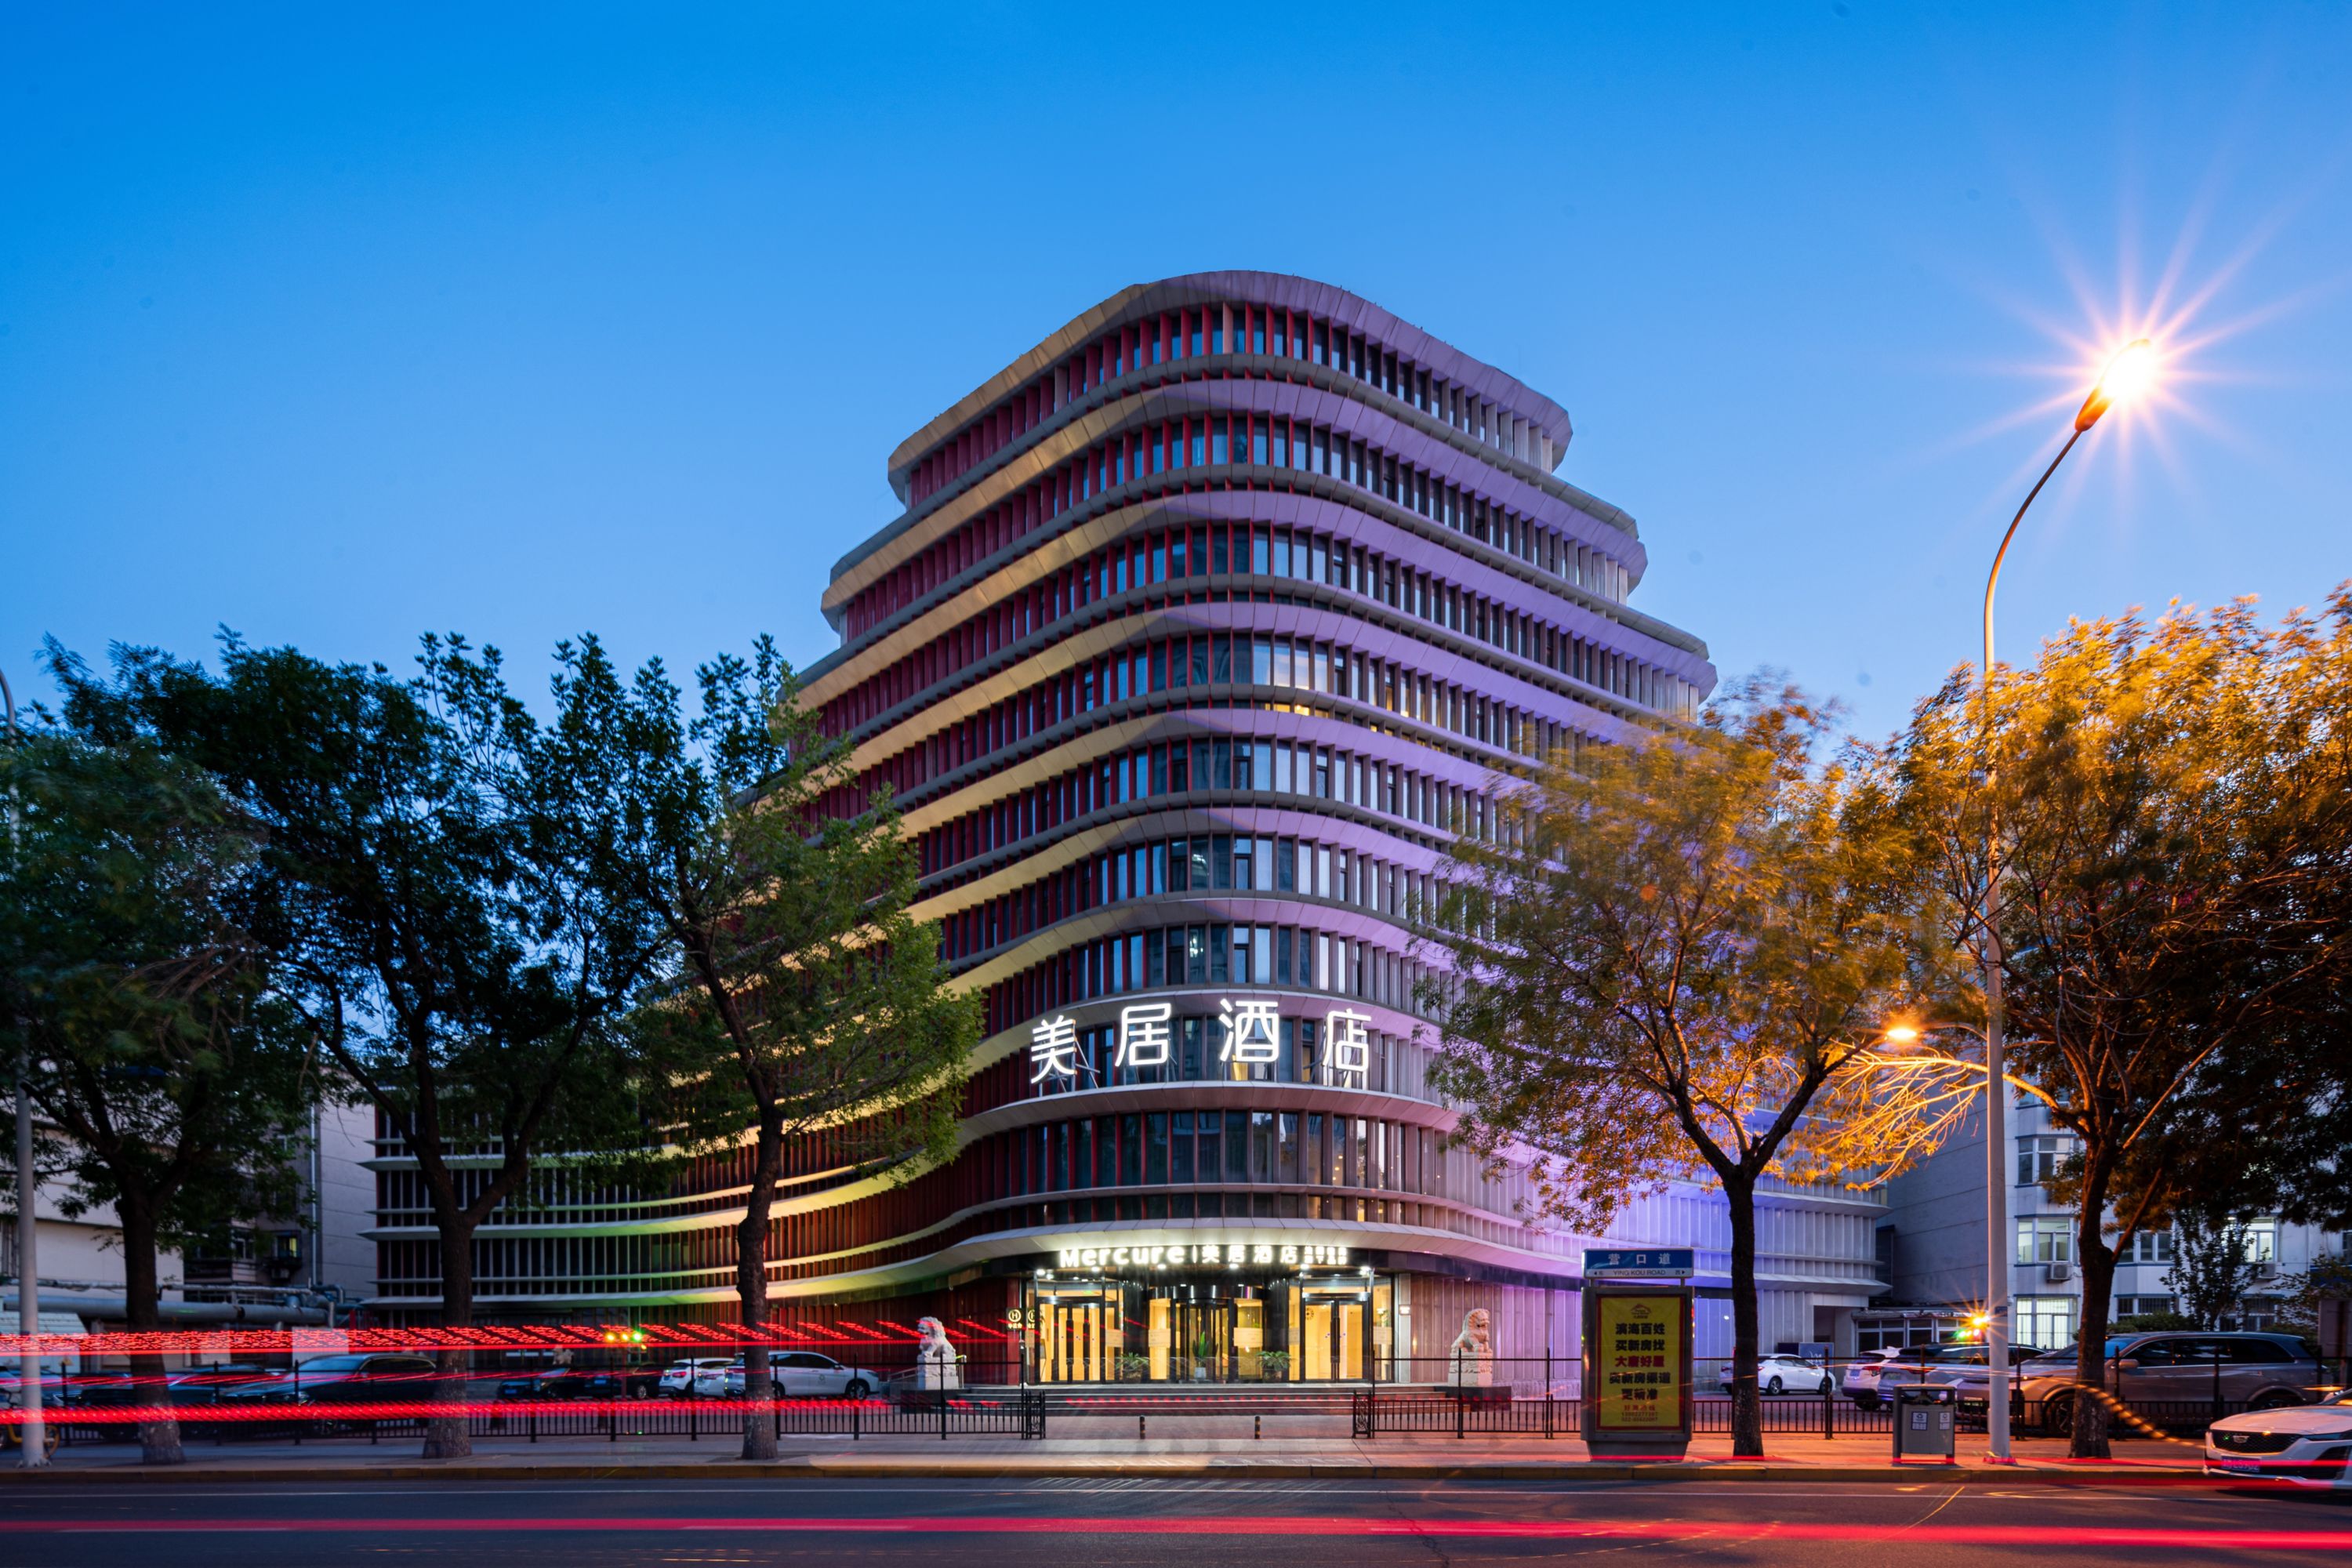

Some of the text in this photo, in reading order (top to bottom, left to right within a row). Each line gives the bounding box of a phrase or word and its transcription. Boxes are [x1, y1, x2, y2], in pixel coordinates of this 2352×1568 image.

[1030, 998, 1371, 1083] 美居酒店
[1059, 1247, 1185, 1268] Mercure
[1202, 1245, 1298, 1264] 美居酒店
[1608, 1253, 1671, 1265] 营口道
[1615, 1323, 1664, 1335] 滨海百姓
[1615, 1339, 1664, 1351] 买新房找
[1621, 1388, 1658, 1400] 更精准
